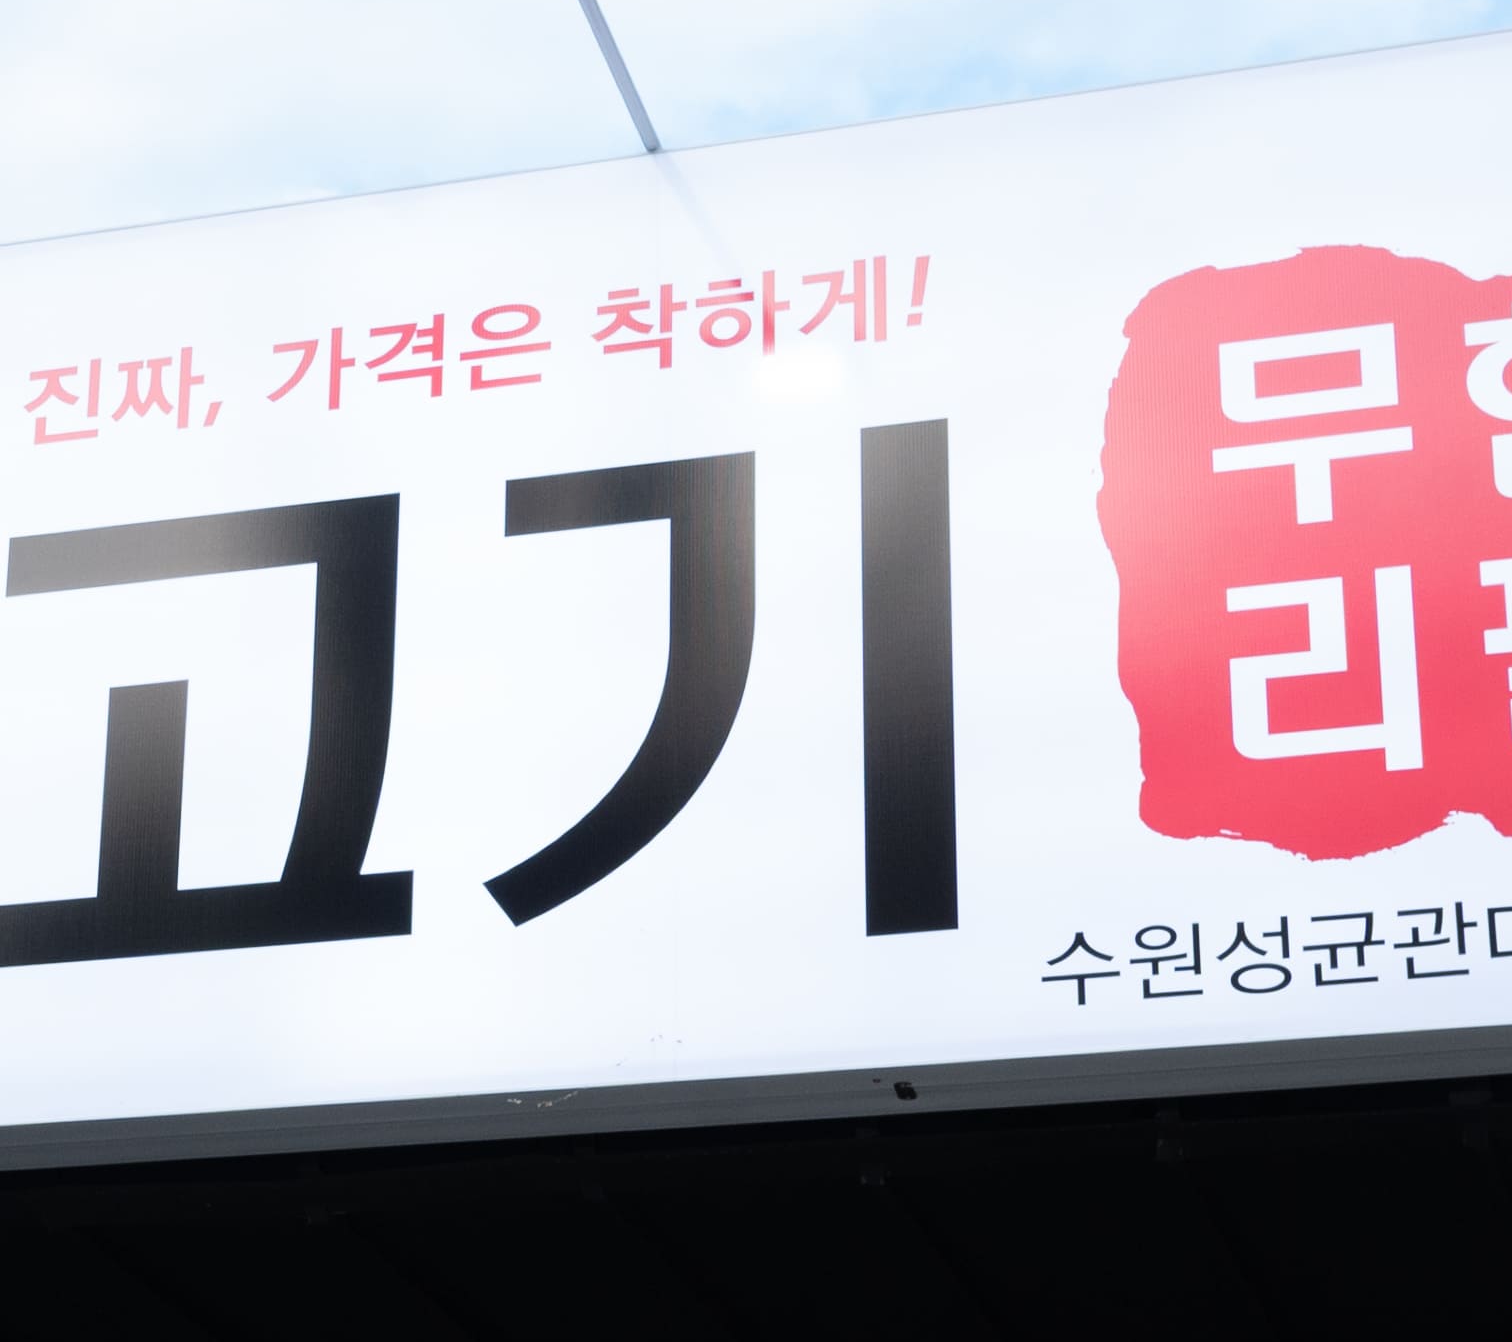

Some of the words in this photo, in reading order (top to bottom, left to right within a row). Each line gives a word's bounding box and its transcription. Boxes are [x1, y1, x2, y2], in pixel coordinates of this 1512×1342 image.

[21, 344, 223, 446] 진짜,
[266, 299, 551, 413] 가격은
[588, 254, 933, 371] 착하게!
